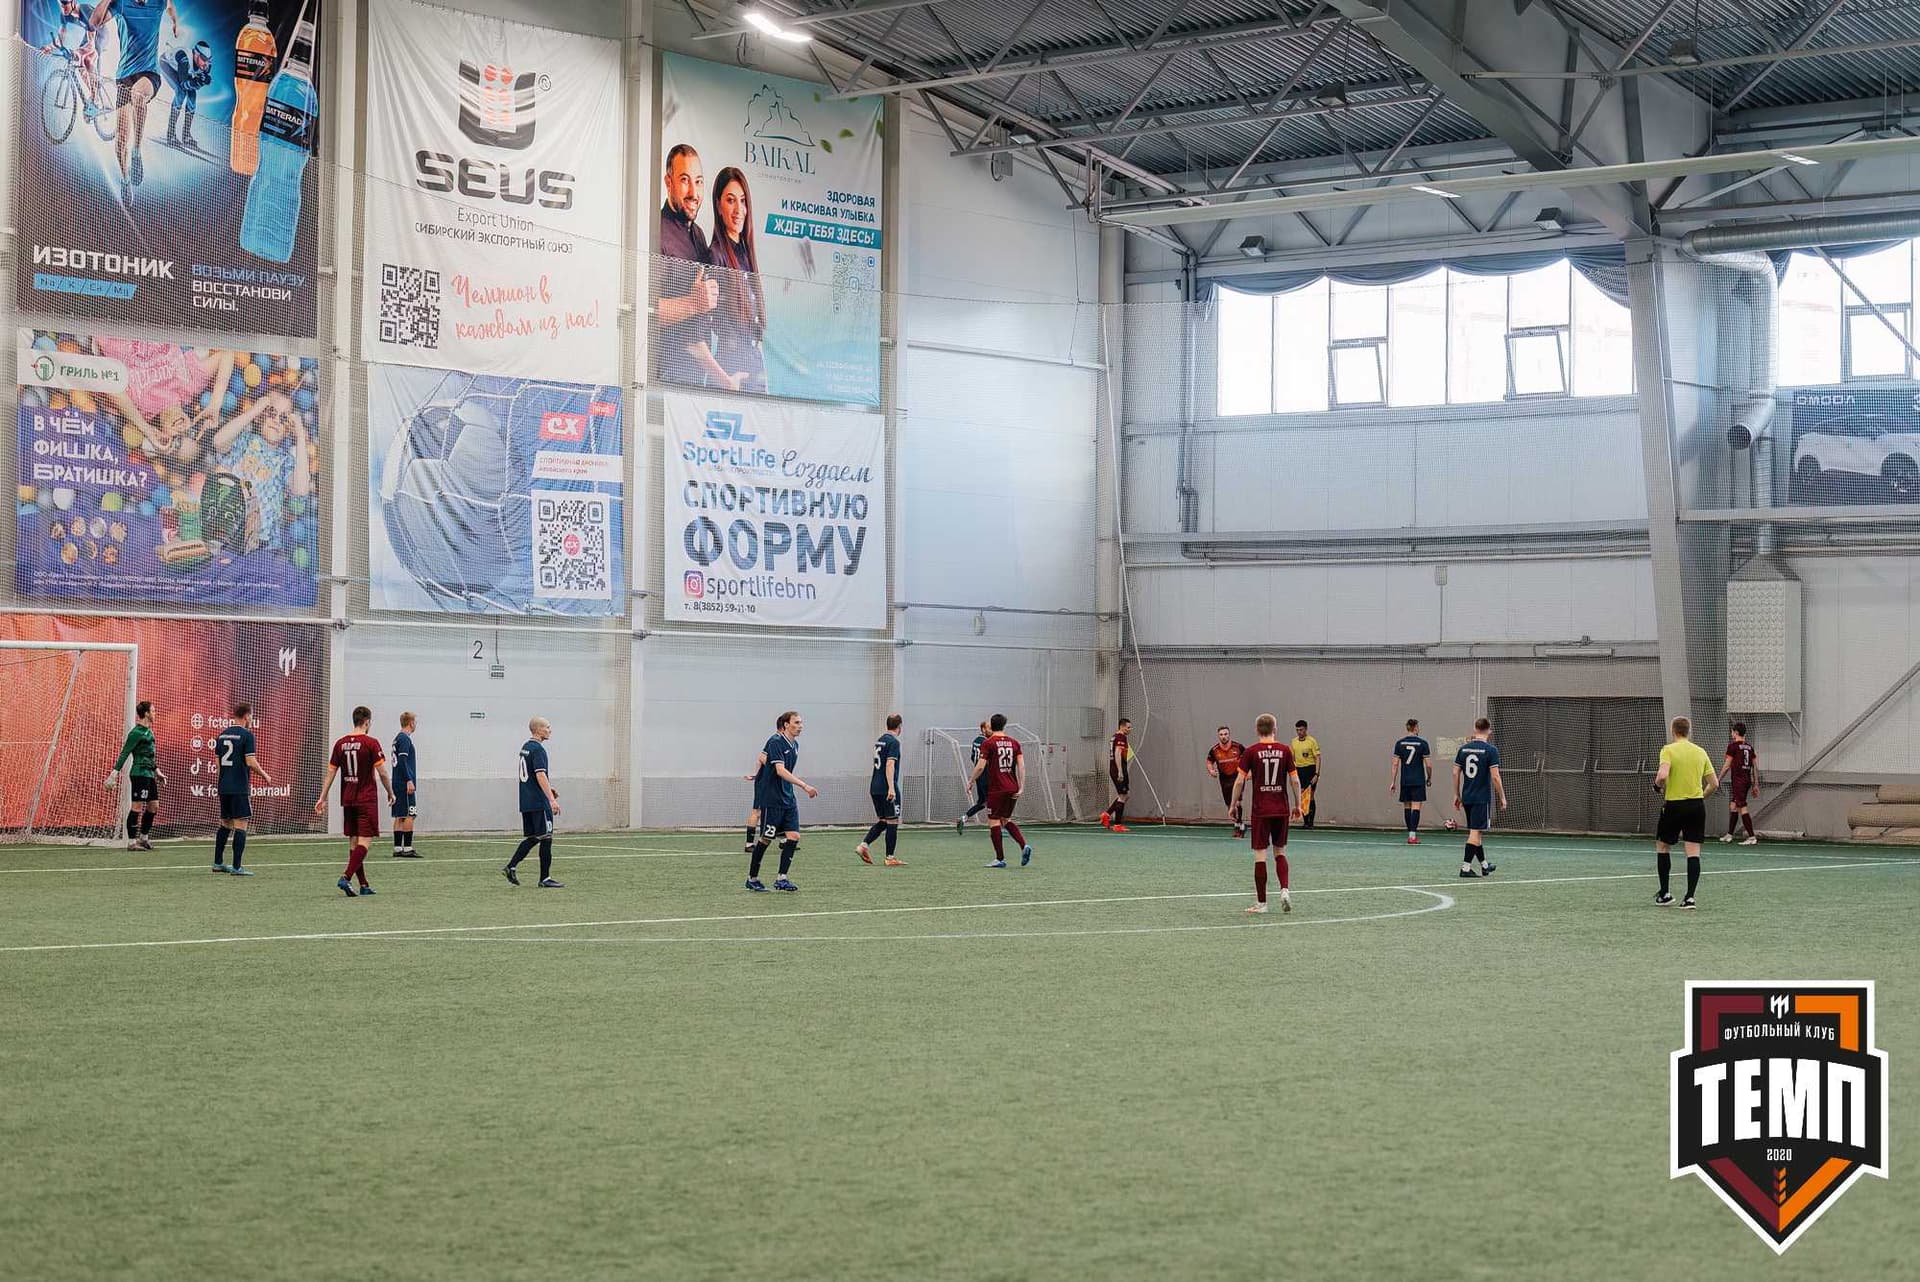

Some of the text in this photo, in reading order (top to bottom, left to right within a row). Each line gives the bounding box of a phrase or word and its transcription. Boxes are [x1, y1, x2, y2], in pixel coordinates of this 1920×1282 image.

[744, 141, 816, 175] BAIKAL
[415, 149, 576, 210] SEUS
[781, 199, 875, 223] И КРАСИВАЯ УЛЫБКА
[826, 190, 875, 208] ЗДОРОВАЯ
[457, 206, 534, 233] Export Union
[773, 218, 875, 245] ЖДЕТ ТЕБЯ ЗДЕСЬ!
[415, 222, 573, 254] СИБИРСКИЙ ЭКСПОРТНЫЙ СОЮЗ
[33, 245, 174, 281] ИЗОТОНИК
[192, 264, 255, 282] ВОЗЬМИ
[192, 280, 291, 302] ВОССТАНОВИ
[192, 295, 239, 312] СИЛЫ.
[451, 274, 536, 308] Чемпион
[455, 299, 600, 340] каждом из нас!
[60, 365, 98, 379] ГРИЛЬ
[34, 410, 95, 436] В ЧЁМ
[703, 410, 756, 443] SL
[34, 440, 119, 465] ФИШКА,
[682, 441, 776, 469] SportLife
[34, 463, 148, 487] БРАТИШКА?
[781, 448, 873, 488] Создаем
[683, 480, 869, 521] СПОРТИВНУЮ
[683, 515, 867, 576] ФОРМУ
[706, 575, 816, 600] sportlifebrn
[473, 640, 483, 659] 2
[221, 740, 234, 766] 2
[344, 750, 358, 777] 11
[997, 746, 1013, 768] 23
[1406, 745, 1416, 765] 7
[1465, 753, 1480, 779] 6
[1743, 749, 1750, 766] 3
[1262, 758, 1280, 786] 17
[765, 824, 777, 837] 23
